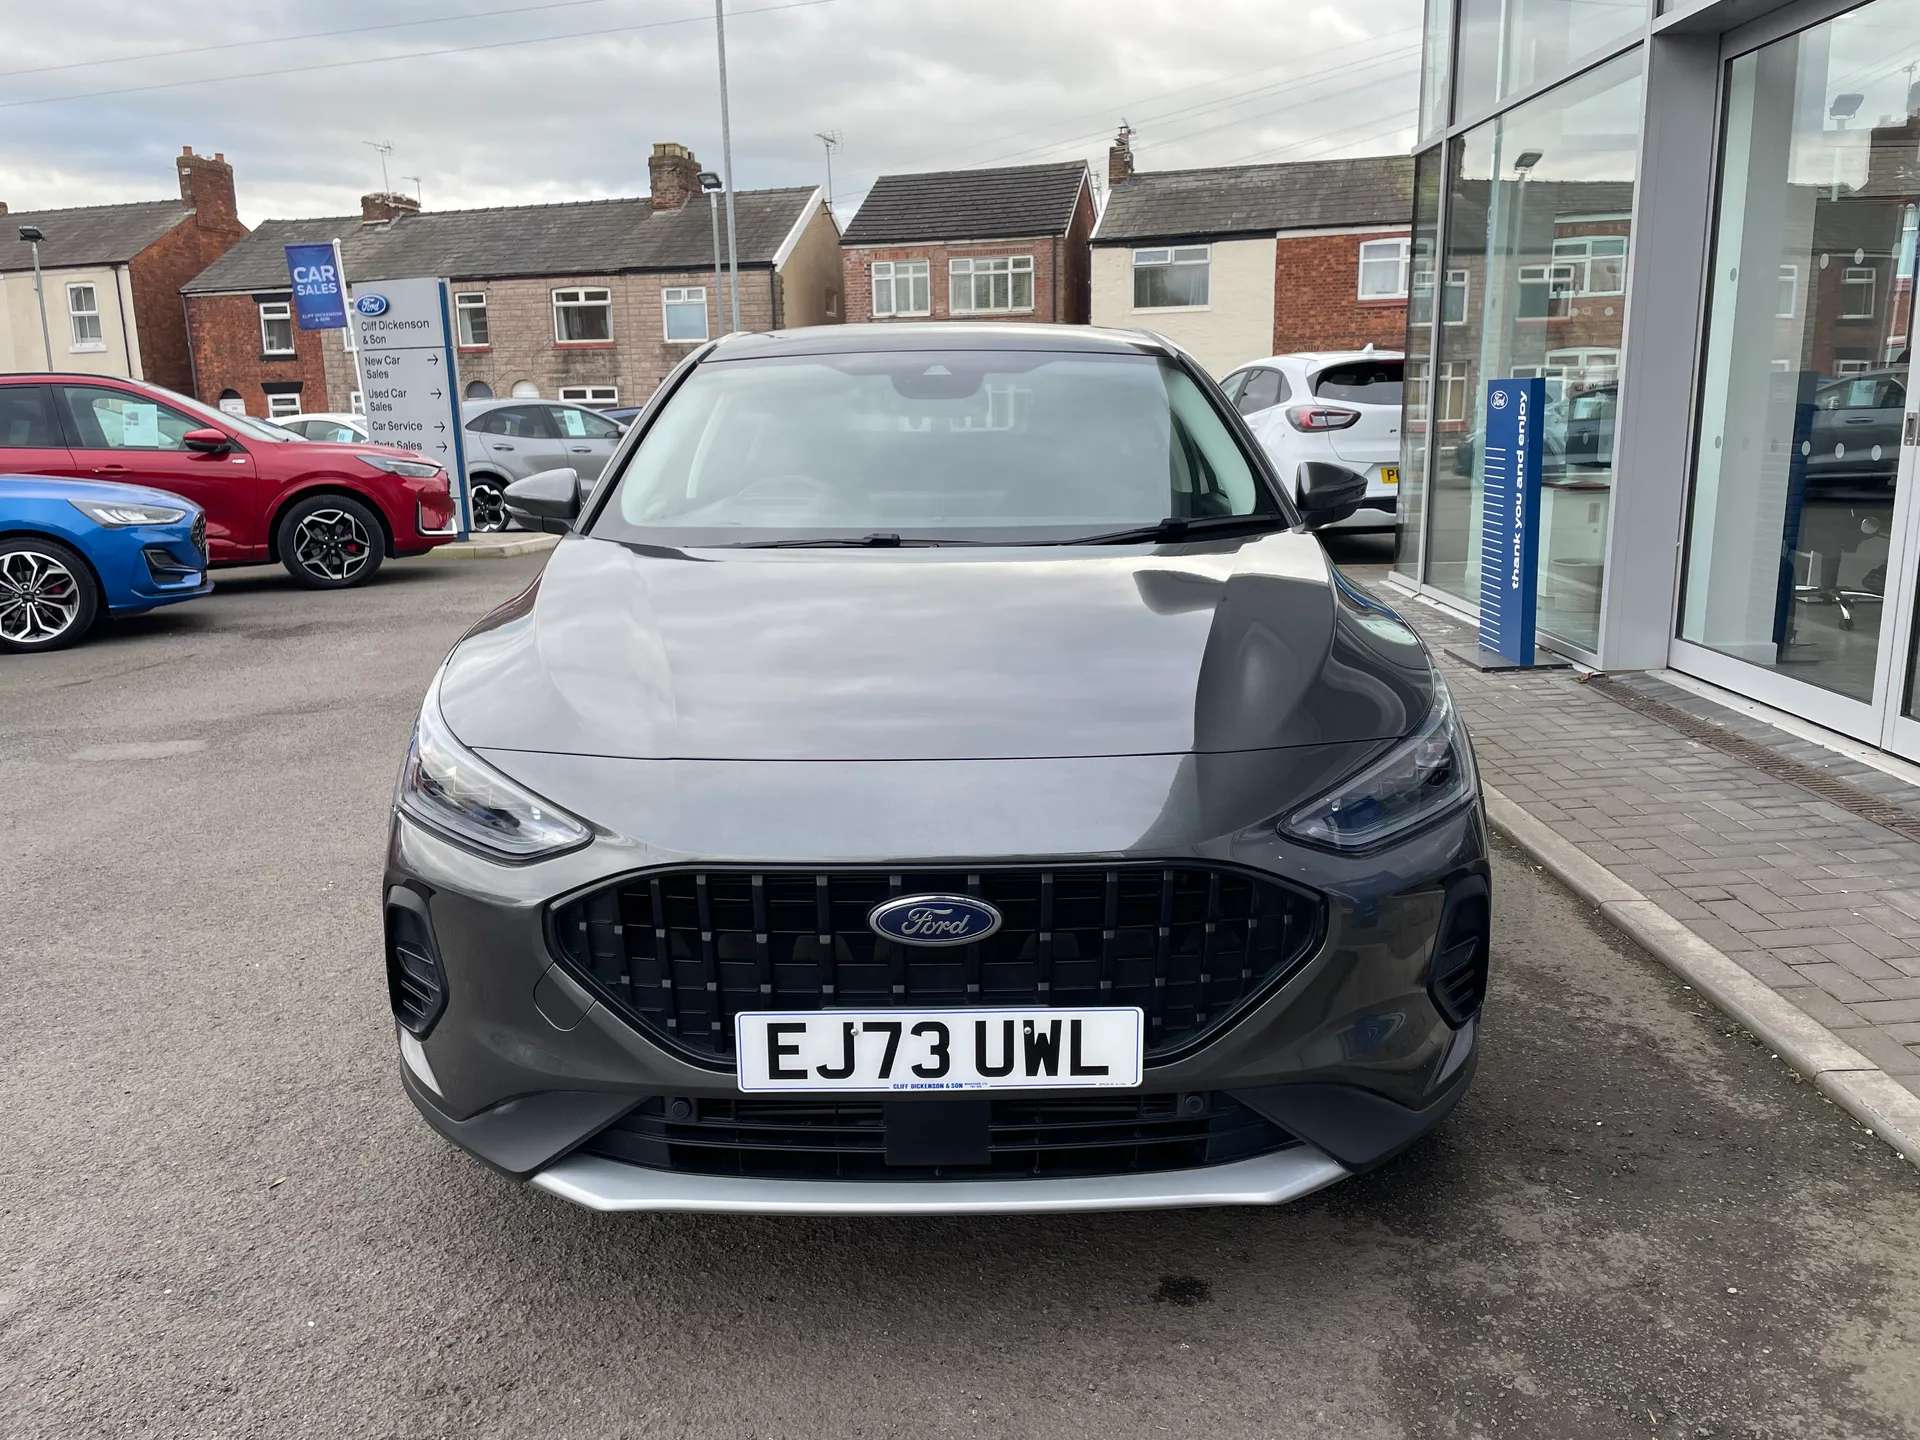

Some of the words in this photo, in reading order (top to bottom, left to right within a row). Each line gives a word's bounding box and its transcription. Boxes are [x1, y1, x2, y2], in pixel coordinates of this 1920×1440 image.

[294, 265, 335, 283] CAR
[297, 283, 337, 296] SALES
[361, 298, 380, 312] Ford
[361, 321, 377, 332] Cliff
[379, 320, 430, 330] Dickenson
[363, 336, 368, 344] &
[369, 334, 386, 344] Son
[364, 356, 383, 366] New
[384, 355, 400, 365] Car
[366, 369, 389, 379] Sales
[368, 389, 389, 398] Used
[391, 388, 407, 398] Car
[370, 402, 392, 411] Sales
[1518, 390, 1527, 446] enjoy
[372, 421, 386, 431] Car
[388, 421, 423, 431] Service
[396, 440, 423, 451] Sales
[1516, 450, 1524, 489] and
[1515, 493, 1523, 529] you
[1511, 533, 1521, 590] thank
[901, 907, 971, 935] Ford
[767, 1021, 950, 1080] EJ73
[975, 1020, 1109, 1078] UWL
